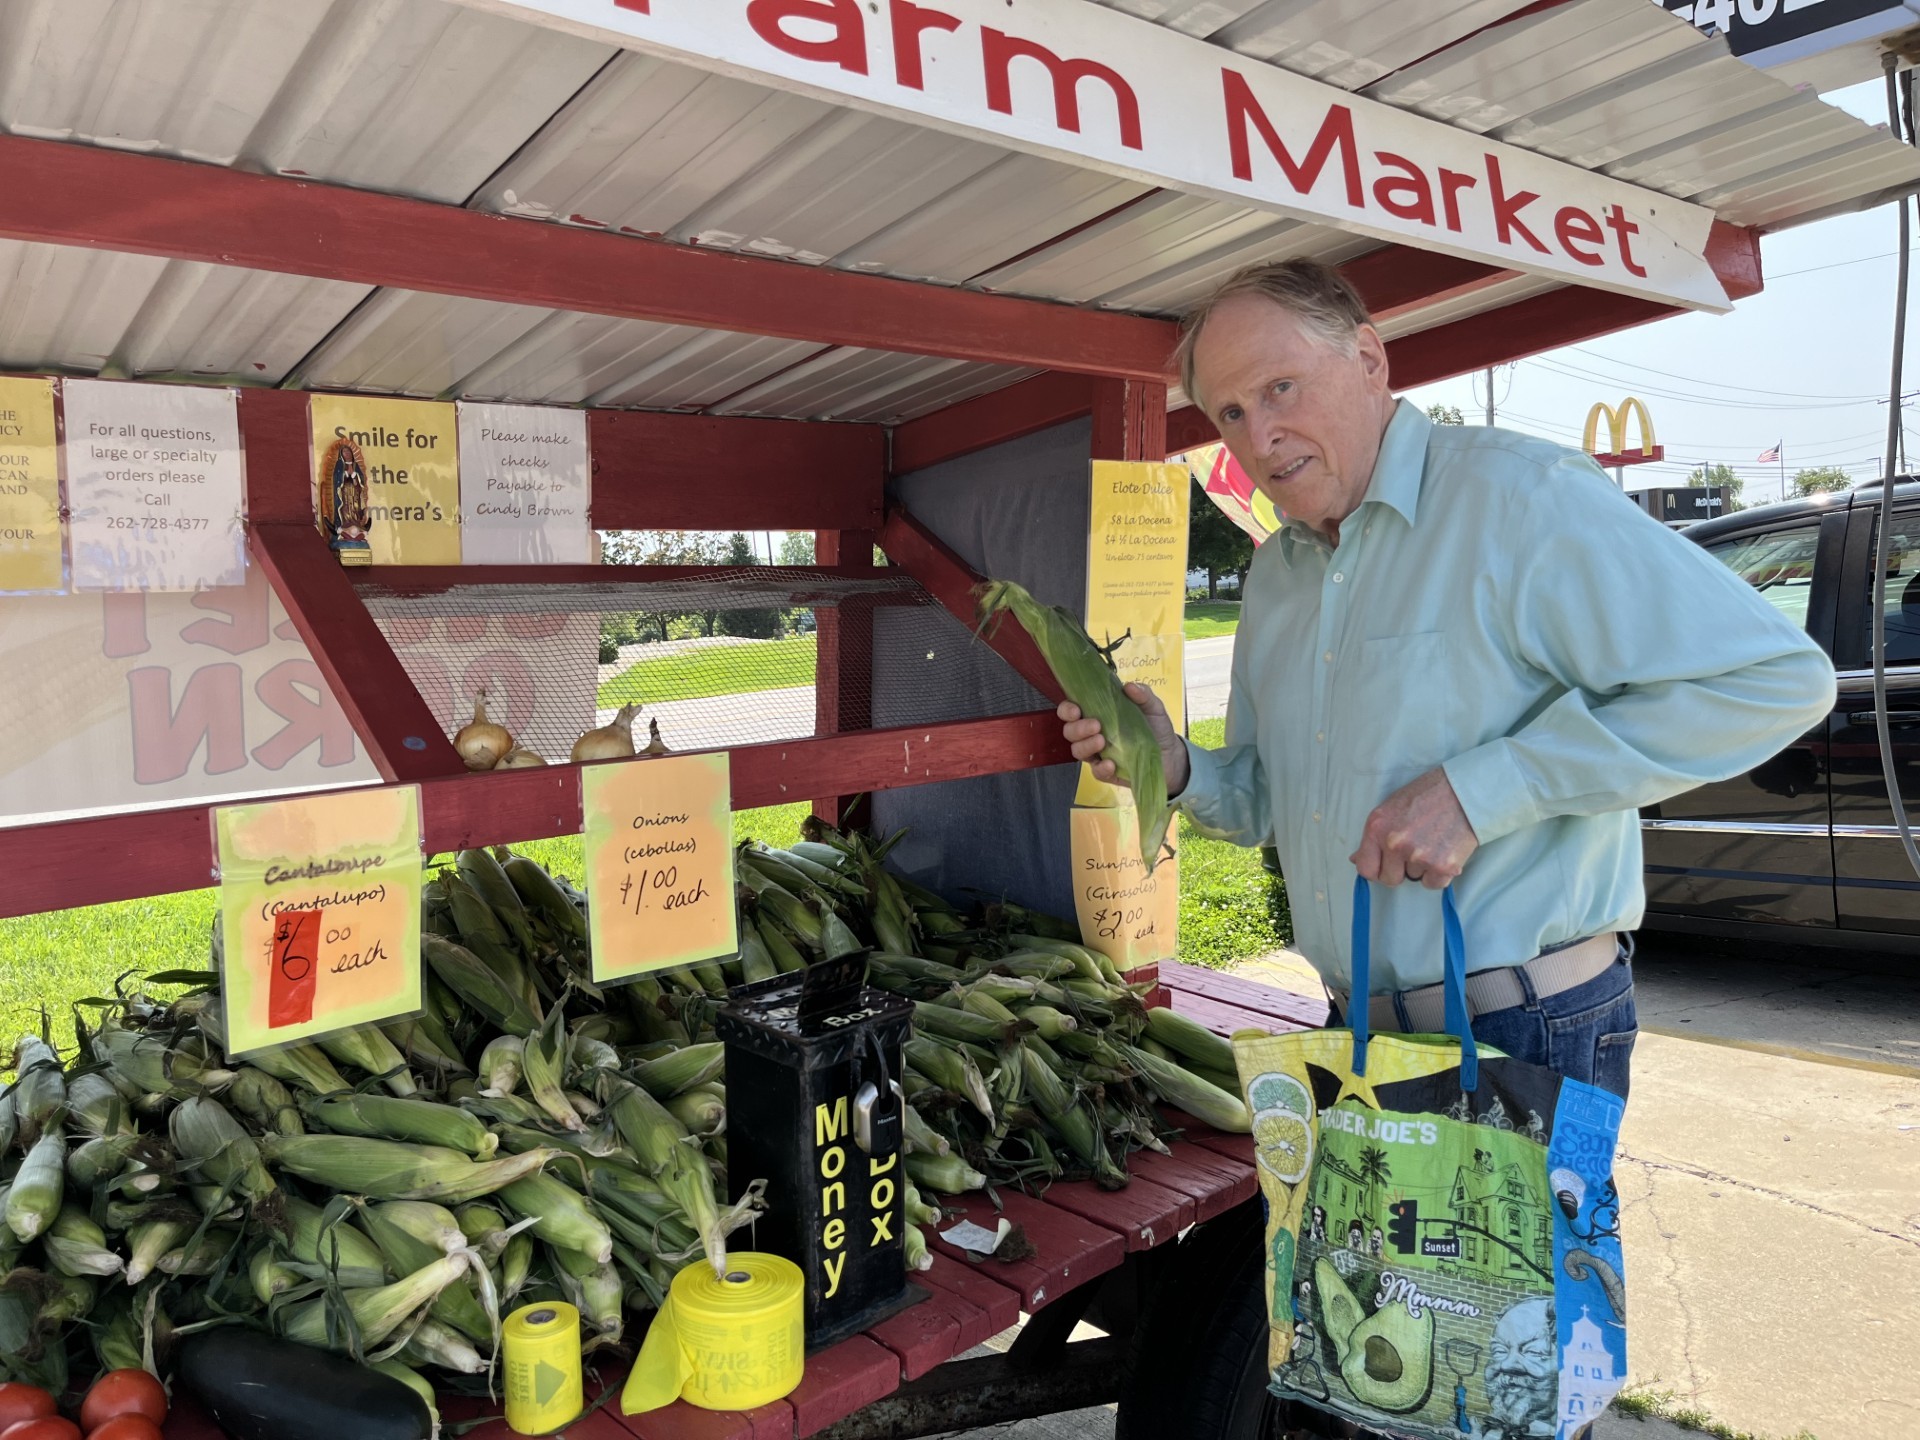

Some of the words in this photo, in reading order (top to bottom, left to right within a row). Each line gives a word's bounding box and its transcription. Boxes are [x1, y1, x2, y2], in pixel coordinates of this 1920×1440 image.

[613, 0, 1144, 152] arm
[1221, 66, 1648, 279] Market
[89, 423, 114, 436] For
[119, 424, 136, 437] all
[141, 427, 216, 443] questions,
[334, 425, 400, 448] Smile
[405, 428, 438, 449] for
[481, 428, 528, 444] Please
[532, 433, 571, 445] make
[90, 445, 129, 462] large
[133, 449, 149, 460] or
[153, 449, 217, 466] specialty
[501, 455, 550, 469] checks
[105, 468, 154, 482] orders
[159, 470, 206, 485] please
[370, 464, 409, 485] the
[487, 478, 547, 494] Payable
[550, 481, 565, 493] to
[1112, 481, 1141, 494] Elote
[1142, 482, 1173, 495] Dulce
[144, 493, 171, 506] Call
[367, 501, 443, 522] mera's
[476, 503, 521, 519] Cindy
[527, 504, 574, 516] Brown
[1111, 514, 1122, 526] $8
[1124, 515, 1137, 525] La
[1138, 515, 1172, 525] Docena
[106, 516, 209, 530] 262-728-4377
[1129, 535, 1141, 545] La
[1143, 535, 1177, 545] Docena
[633, 812, 690, 829] Onions
[624, 837, 697, 864] (cebollas)
[264, 855, 387, 886] Cantaloupe
[663, 878, 710, 910] each
[1086, 879, 1157, 901] (Girasoles)
[261, 884, 386, 922] (Cantalupo)
[331, 939, 388, 973] each
[822, 1006, 883, 1028] Box
[1317, 1108, 1366, 1138] TRADER
[1367, 1118, 1438, 1146] JOE'S
[1554, 1121, 1613, 1157] San
[815, 1095, 849, 1299] Money
[1424, 1241, 1456, 1254] Sunset
[1374, 1271, 1481, 1319] Mmmm
